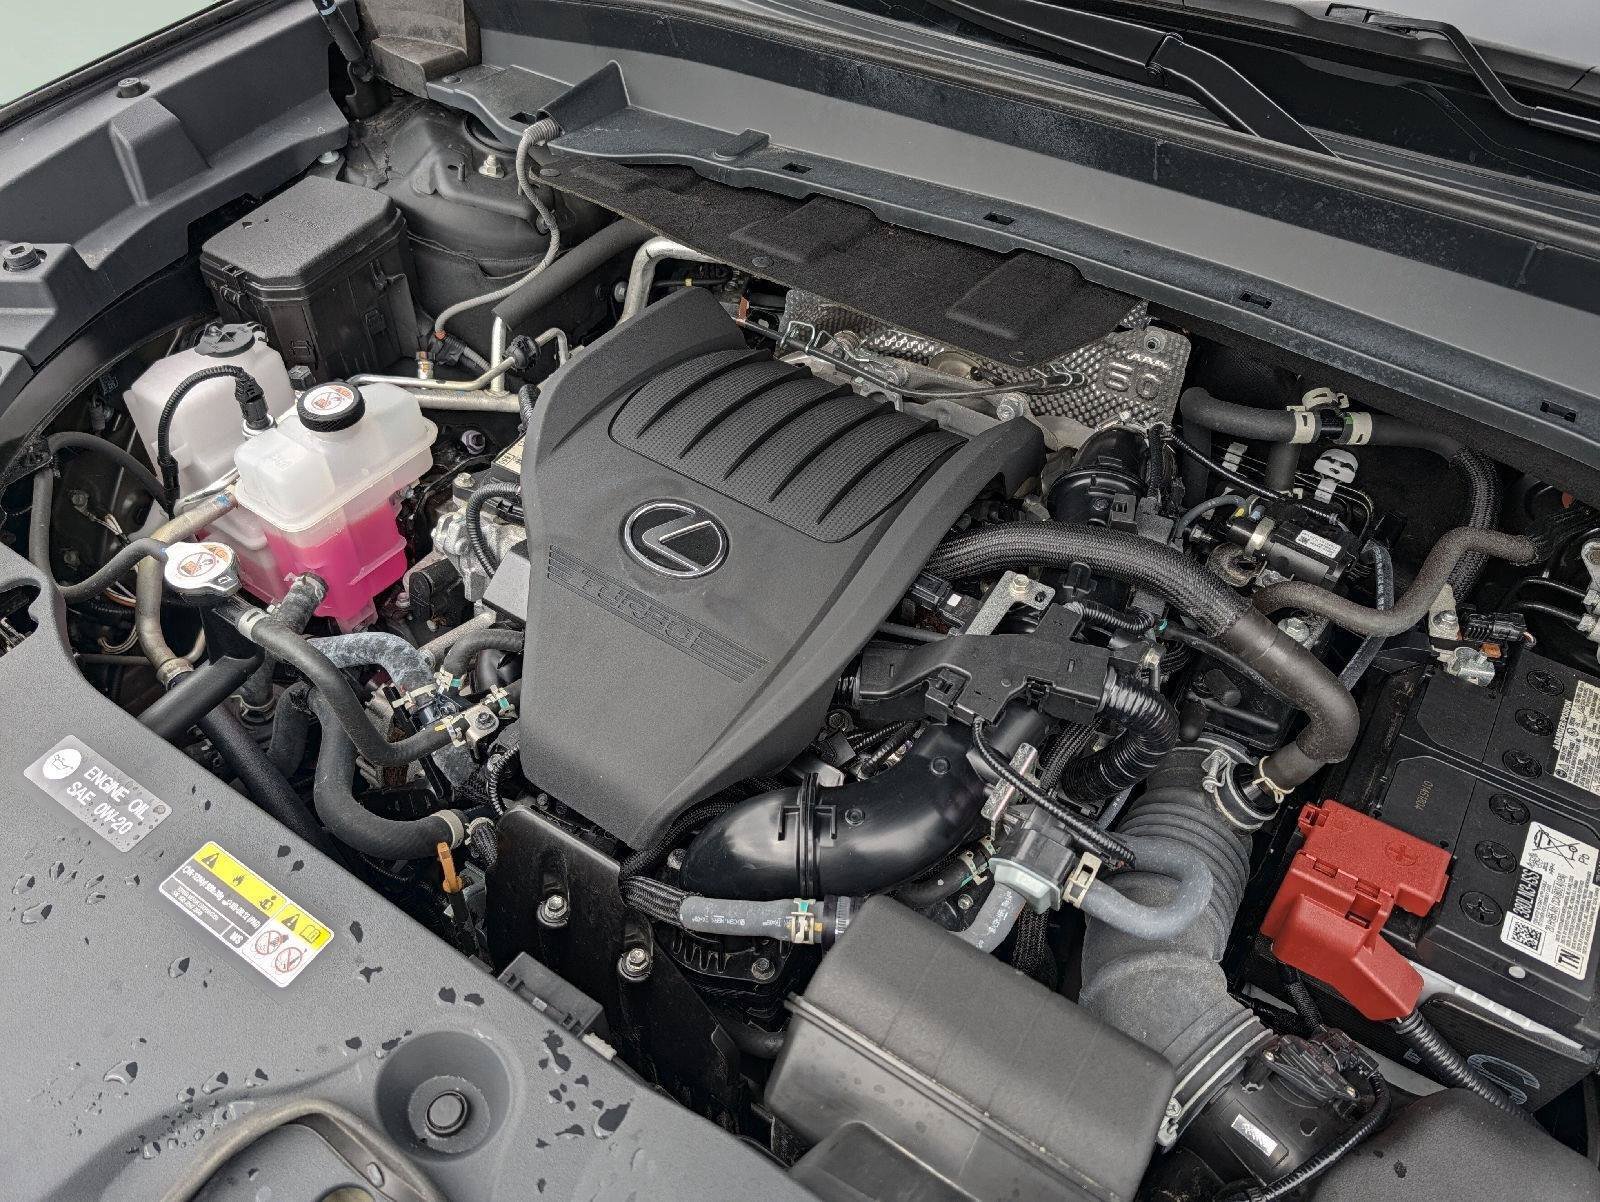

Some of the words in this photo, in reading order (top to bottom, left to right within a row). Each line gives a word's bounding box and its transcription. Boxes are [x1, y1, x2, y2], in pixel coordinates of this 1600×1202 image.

[581, 566, 692, 644] TURBO
[67, 782, 96, 805] SAE
[94, 803, 133, 834] 0W-20
[84, 766, 130, 802] ENGINE
[128, 799, 150, 820] OIL
[1558, 948, 1580, 969] TN
